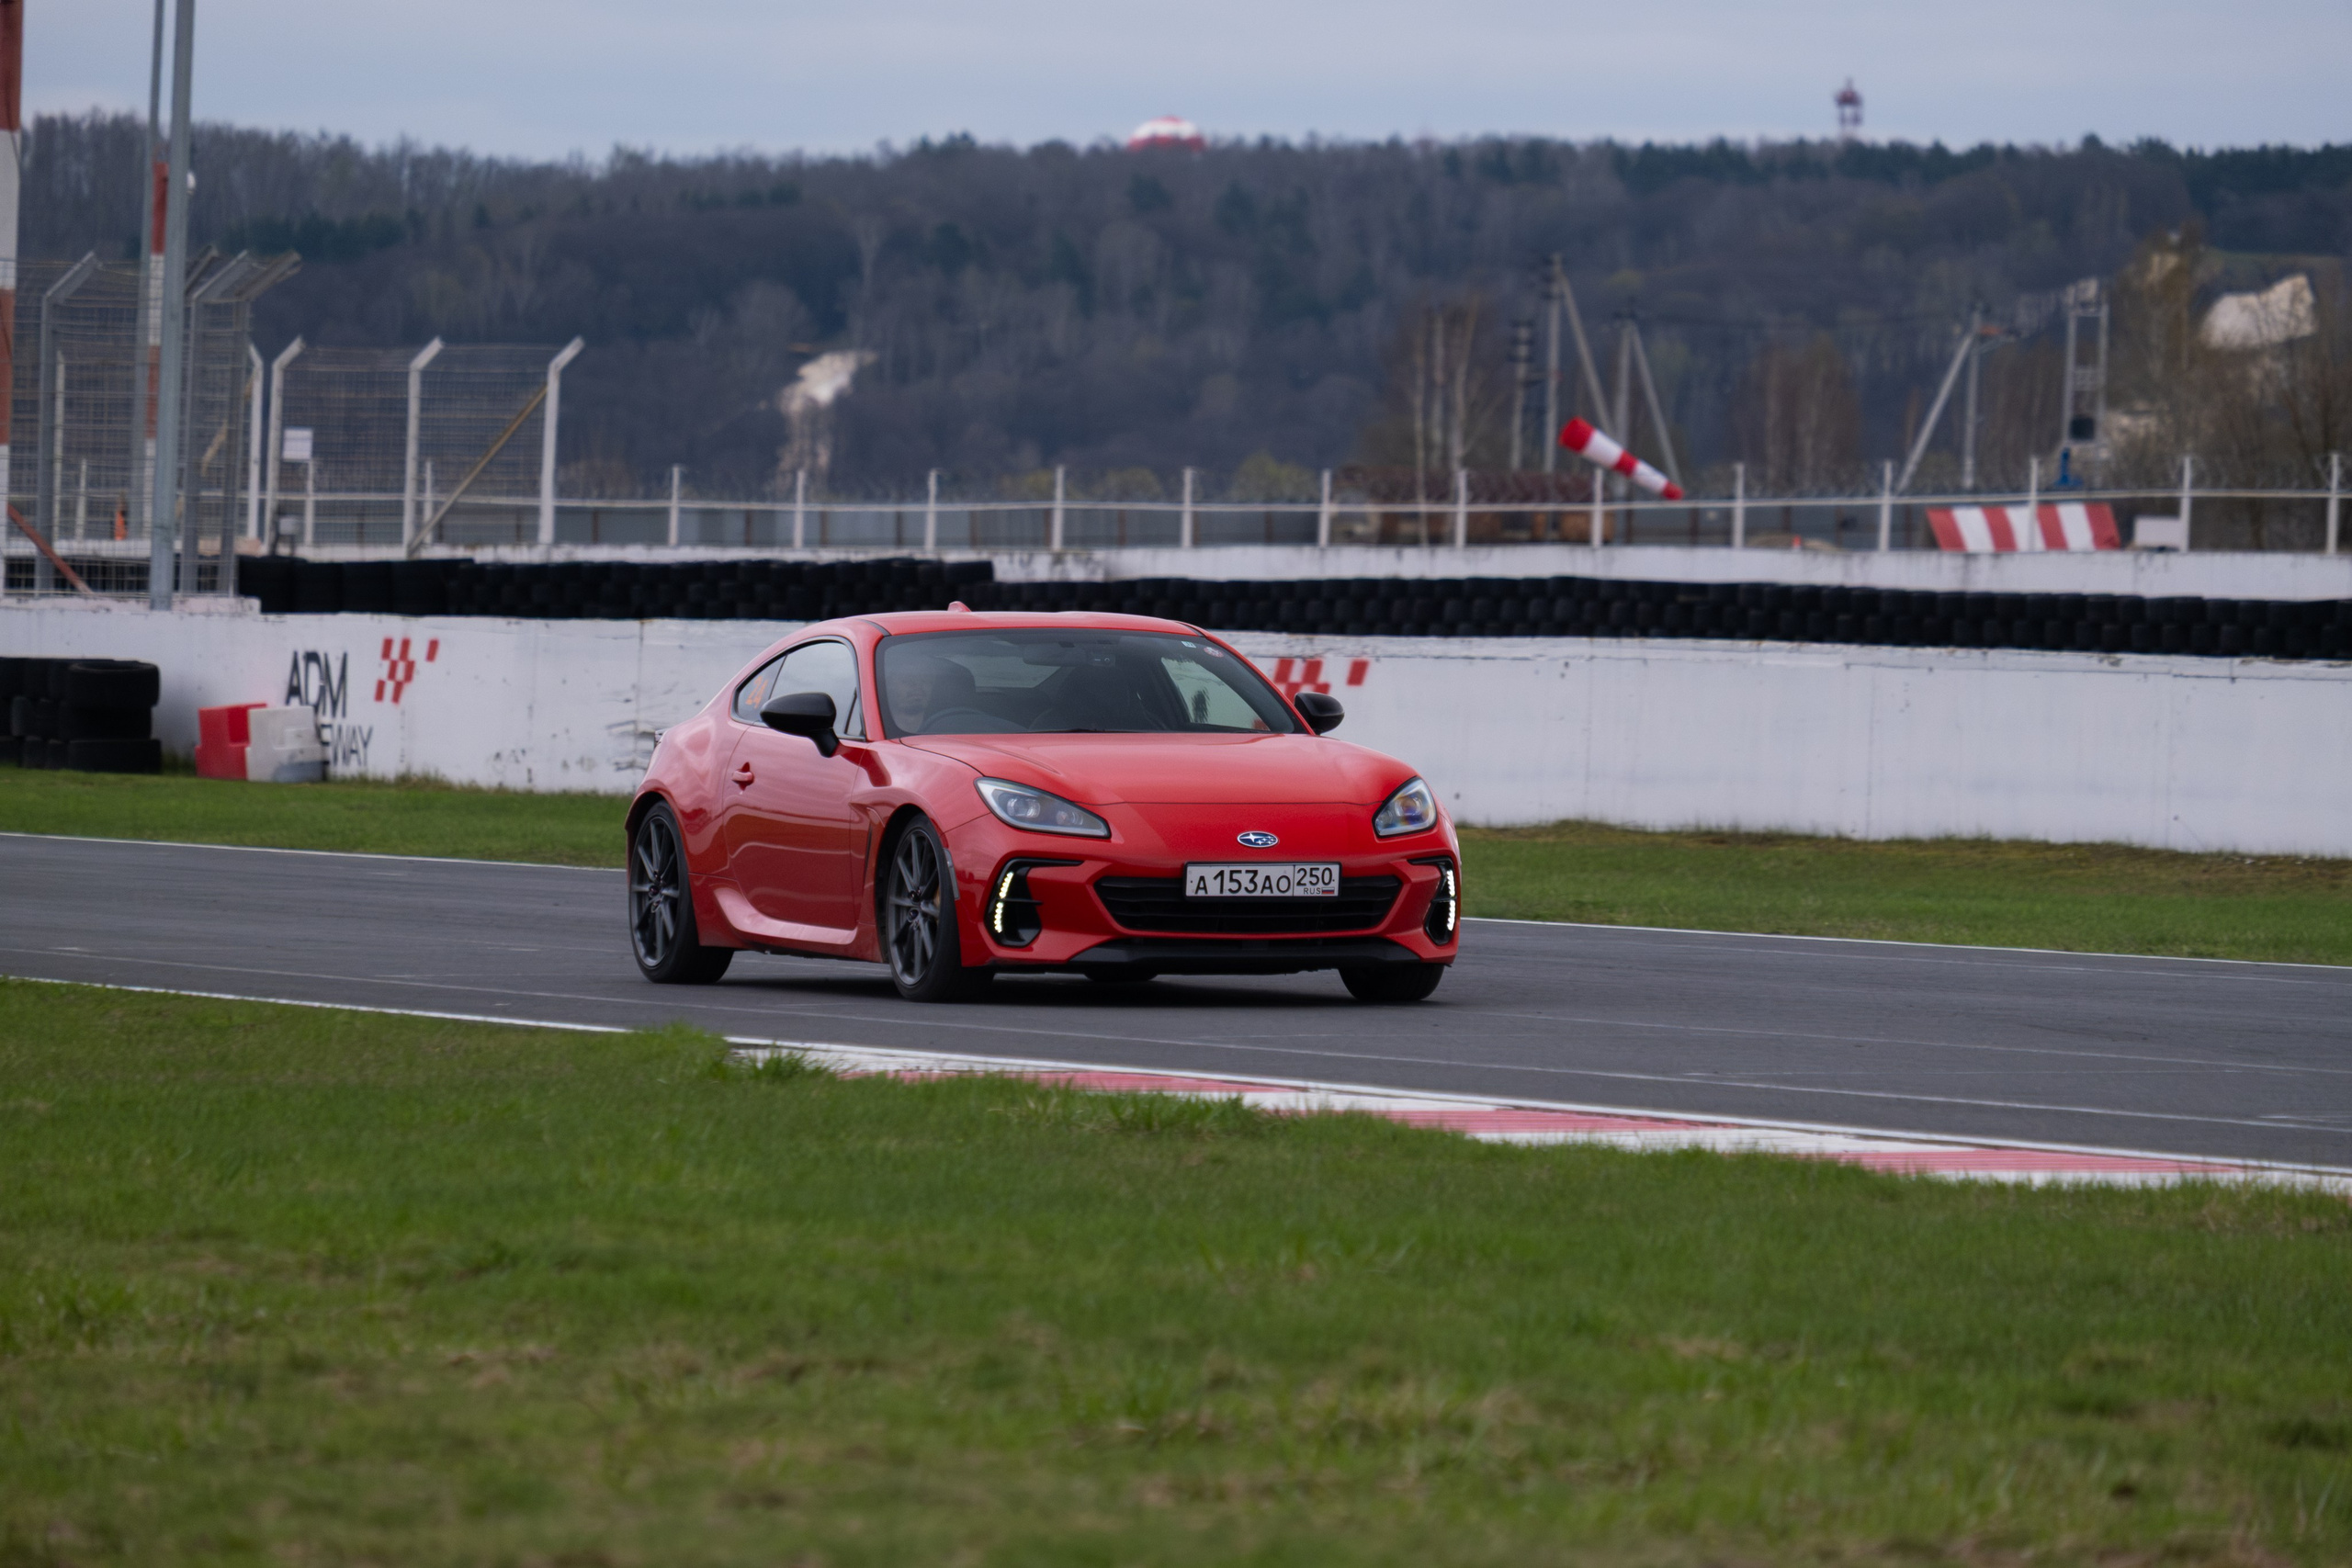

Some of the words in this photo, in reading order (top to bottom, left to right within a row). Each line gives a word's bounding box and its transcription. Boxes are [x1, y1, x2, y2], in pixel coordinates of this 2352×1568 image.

[285, 650, 348, 718] ADM
[318, 724, 373, 766] EWAY
[1194, 869, 1292, 895] A153AO
[1295, 867, 1333, 886] 250
[1303, 886, 1321, 895] RUS
